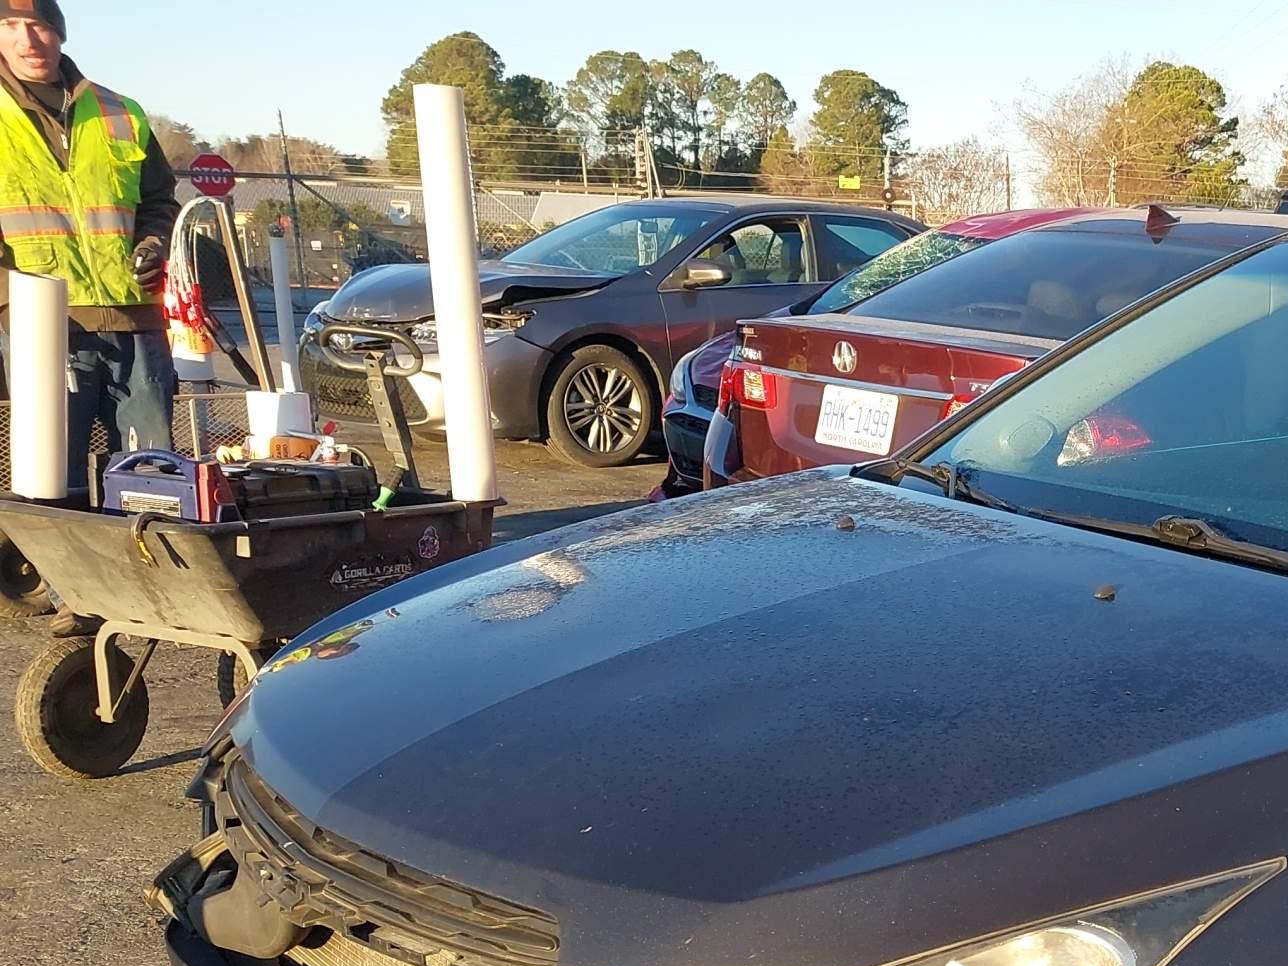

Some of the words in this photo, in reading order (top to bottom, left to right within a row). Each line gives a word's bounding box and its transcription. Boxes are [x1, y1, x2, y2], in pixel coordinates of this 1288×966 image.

[193, 167, 231, 184] STOP
[822, 401, 889, 438] RHK-1499
[344, 567, 380, 579] GORILLA
